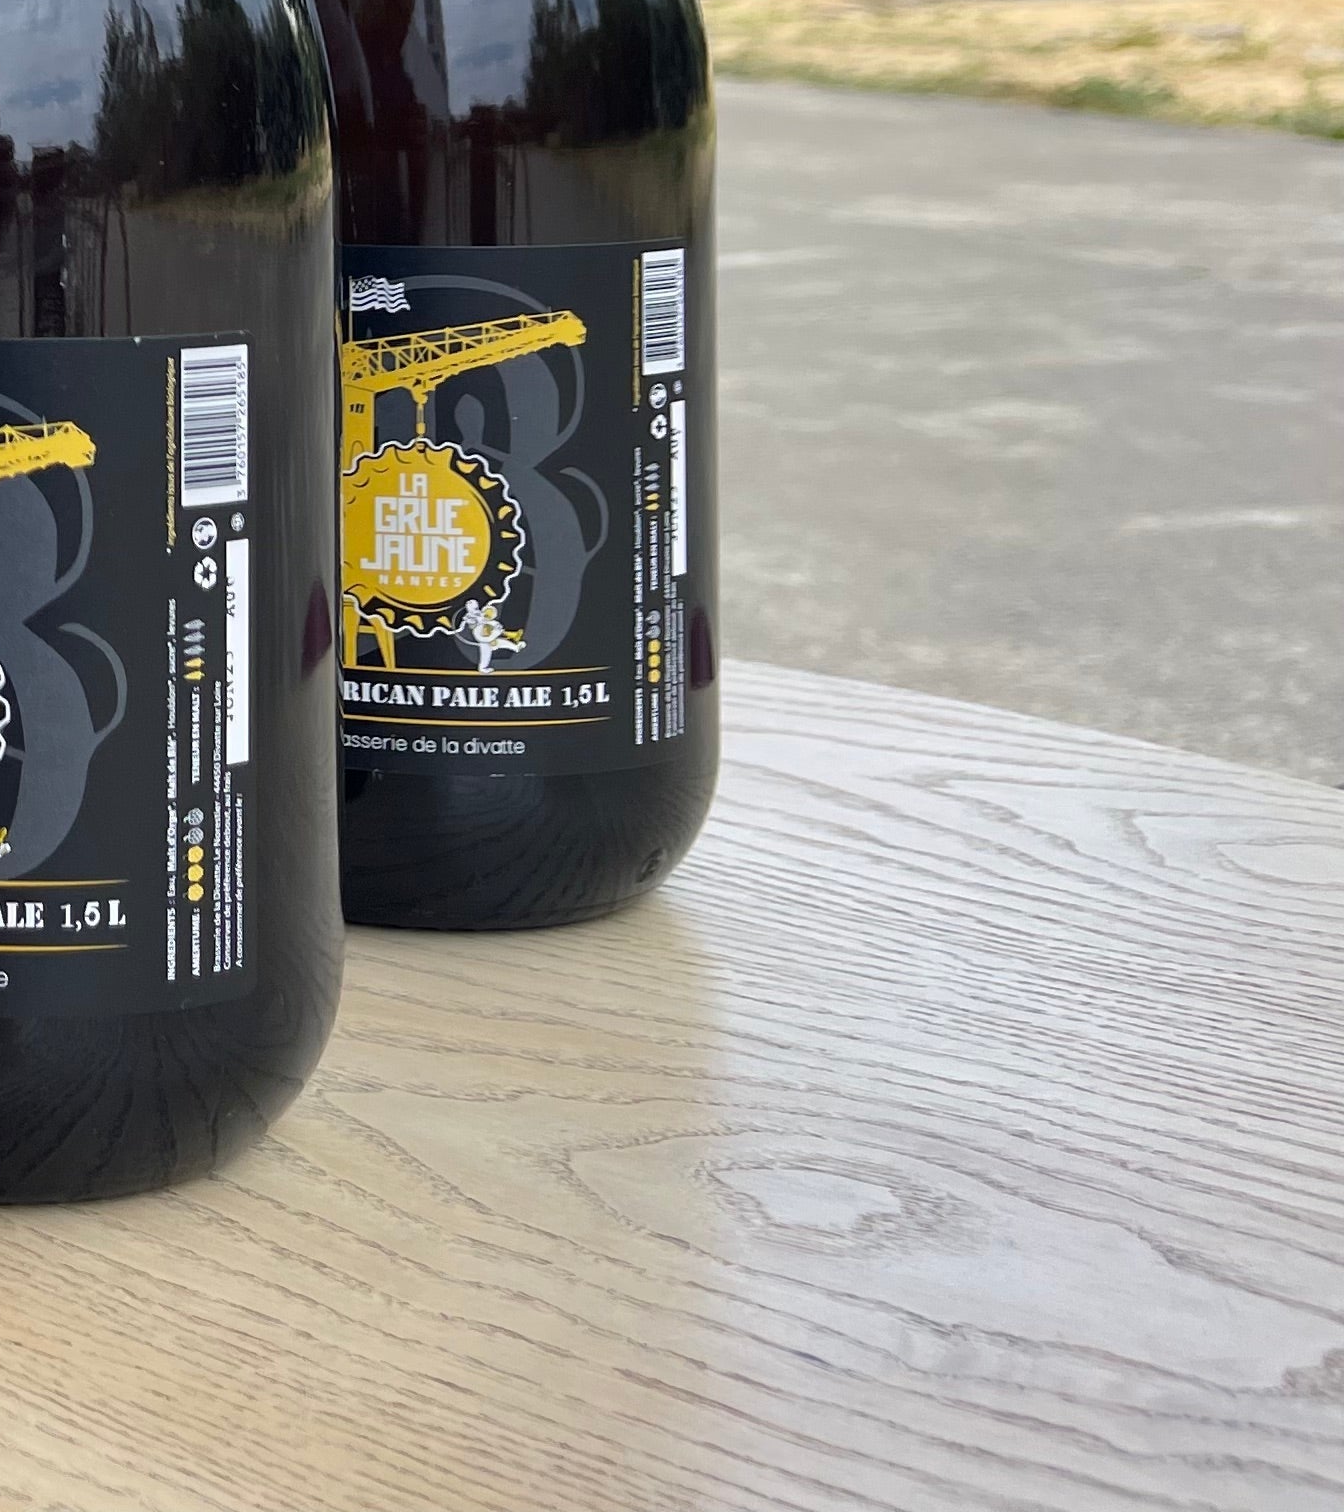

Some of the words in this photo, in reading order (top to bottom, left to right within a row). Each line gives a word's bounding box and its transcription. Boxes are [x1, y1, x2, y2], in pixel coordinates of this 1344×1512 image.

[236, 424, 246, 478] 760157
[399, 473, 428, 496] LA
[375, 496, 467, 535] GRUE
[359, 533, 476, 574] JAUNE
[379, 574, 462, 588] NANTES
[192, 694, 201, 722] MALT
[213, 681, 222, 706] Loire
[343, 680, 425, 707] RICAN
[432, 687, 499, 707] PALE
[504, 687, 552, 708] ALE
[562, 684, 592, 708] 1,5
[596, 682, 610, 703] L
[192, 723, 201, 738] EN
[213, 708, 222, 724] sur
[213, 726, 222, 761] Divatte
[343, 733, 408, 752] asserie
[412, 735, 437, 753] de
[442, 736, 459, 754] la
[464, 737, 525, 755] divatte
[192, 740, 201, 784] TENEUR
[60, 901, 101, 932] 1,5
[108, 899, 126, 926] L
[167, 908, 177, 980] INGREDIENTS
[213, 928, 222, 972] Brasserie
